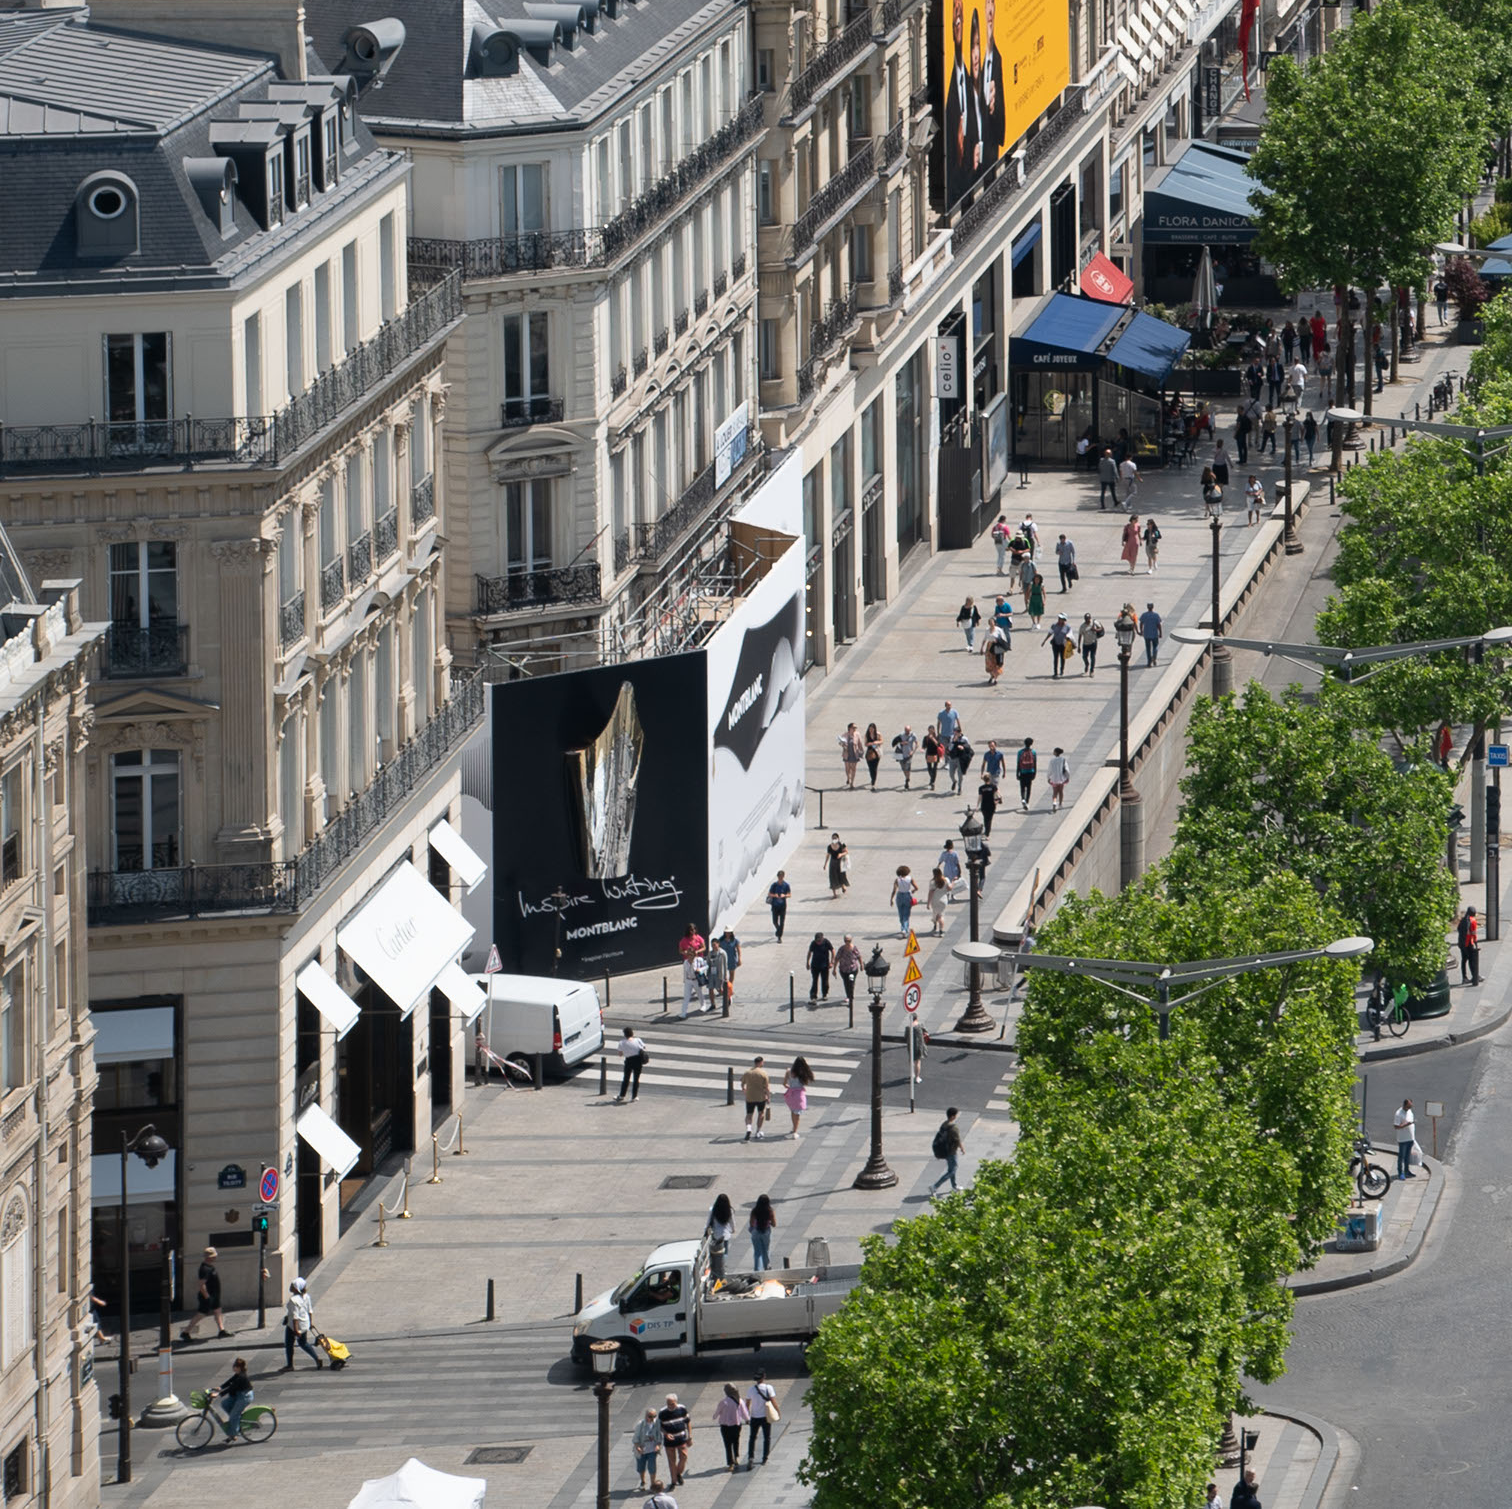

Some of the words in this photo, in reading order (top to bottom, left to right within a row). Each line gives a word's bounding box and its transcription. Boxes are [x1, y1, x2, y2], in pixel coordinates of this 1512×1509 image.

[1158, 216, 1198, 227] FLORA
[1203, 217, 1248, 227] DANICA
[1033, 353, 1051, 363] CAFÉ
[1052, 355, 1077, 363] JOYEUX
[729, 673, 763, 731] MONTBLANC
[566, 916, 639, 941] MONTBLANC
[375, 915, 420, 961] Cartier
[907, 990, 918, 1005] 30
[664, 1320, 674, 1328] TP
